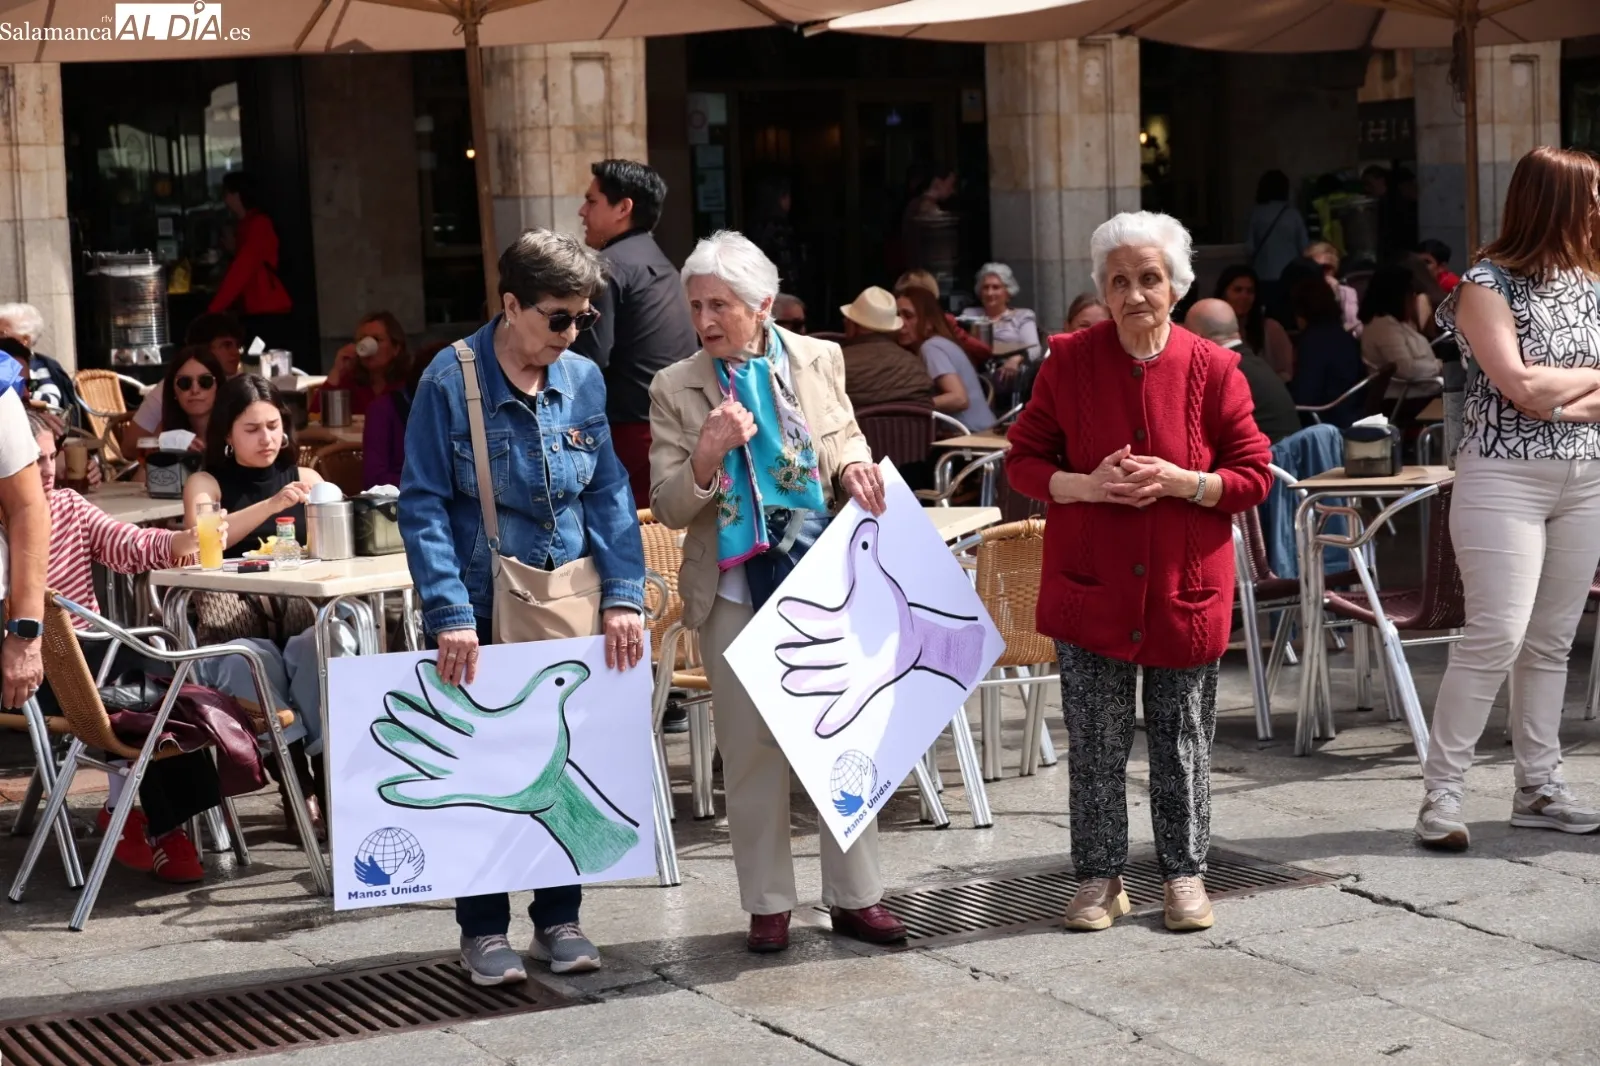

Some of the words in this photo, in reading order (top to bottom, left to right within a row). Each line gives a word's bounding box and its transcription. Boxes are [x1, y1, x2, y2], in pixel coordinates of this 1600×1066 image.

[843, 809, 867, 838] Manos
[866, 779, 892, 809] Unidas
[348, 889, 387, 900] Manos
[391, 884, 432, 895] Unidas
